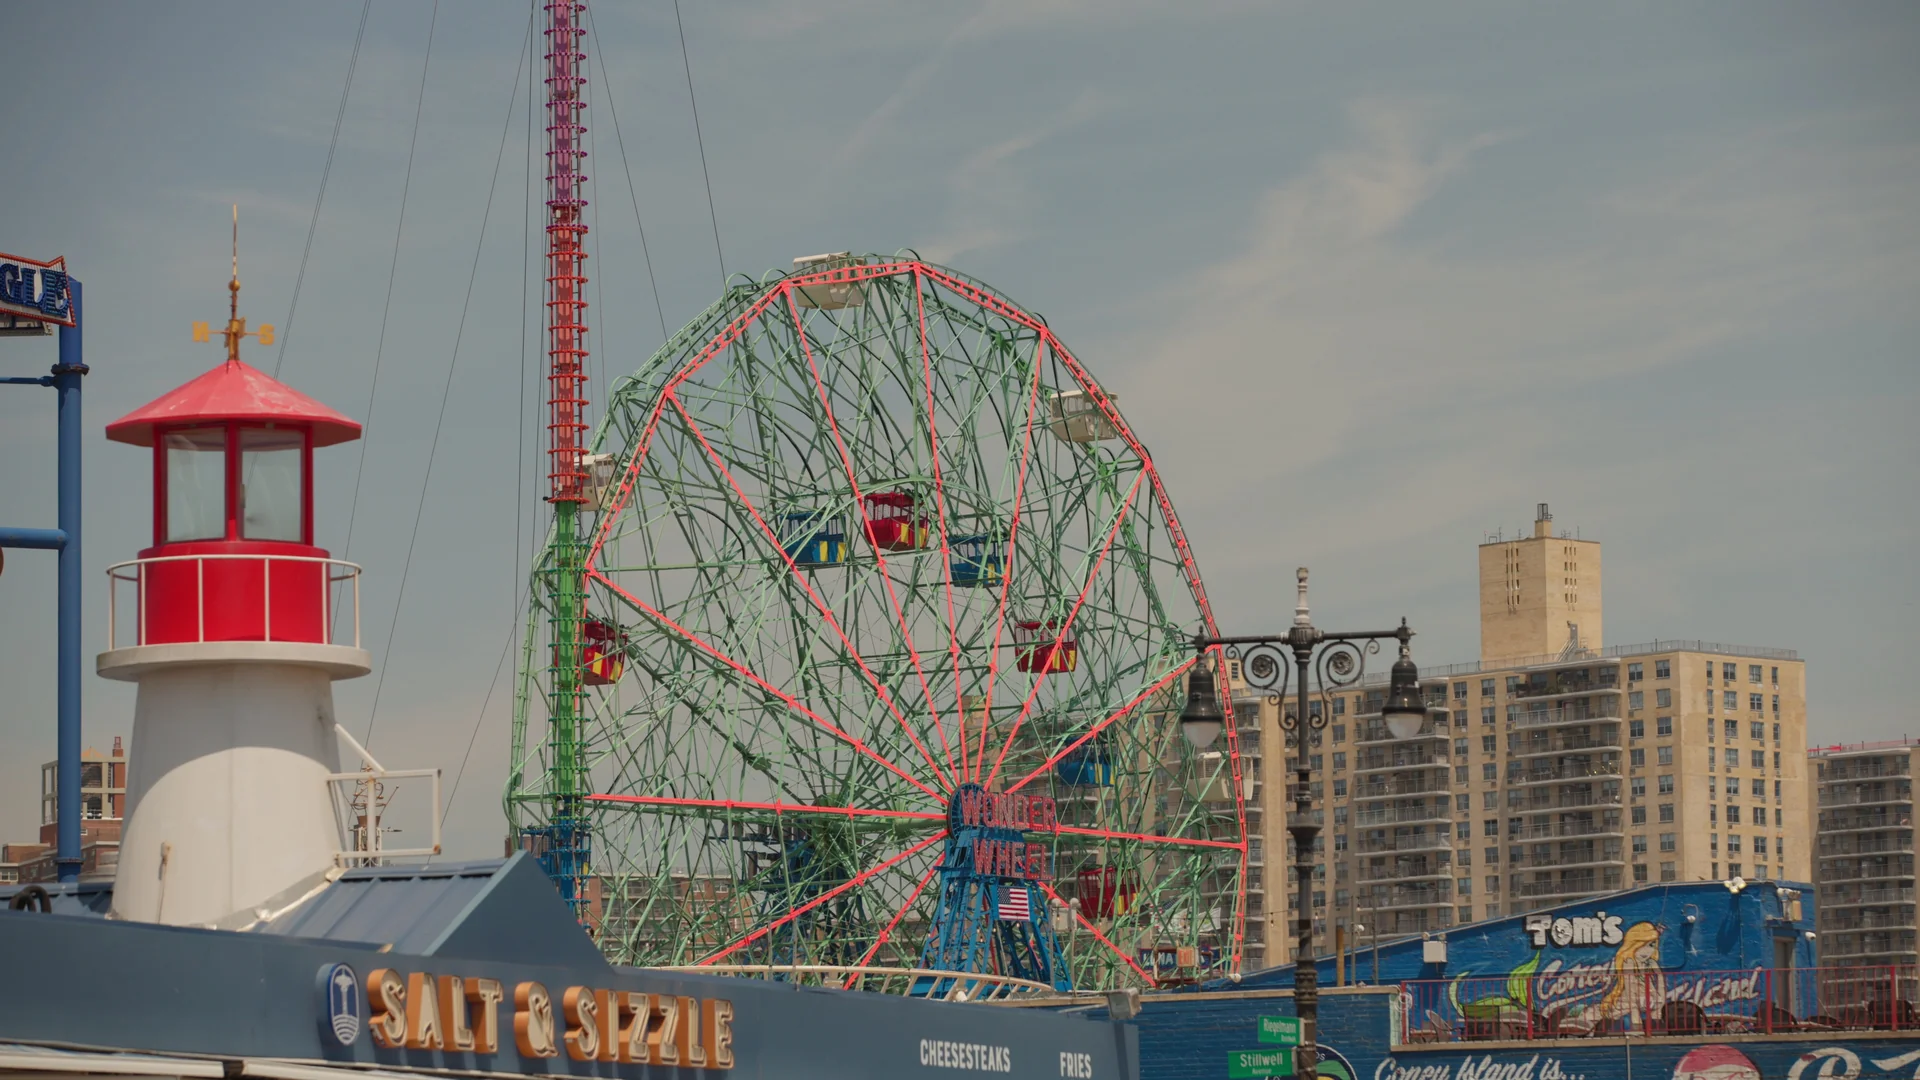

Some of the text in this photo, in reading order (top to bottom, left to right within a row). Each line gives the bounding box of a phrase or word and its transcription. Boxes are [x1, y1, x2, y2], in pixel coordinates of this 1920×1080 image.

[961, 789, 1057, 831] WONDER
[972, 837, 1054, 880] WHEEL
[367, 968, 734, 1069] SALT & SIZZLE
[920, 1038, 1011, 1073] CHEESESTEAKS
[1059, 1051, 1092, 1079] FRIES
[1240, 1052, 1283, 1068] Stillwell
[1457, 1053, 1539, 1080] Island
